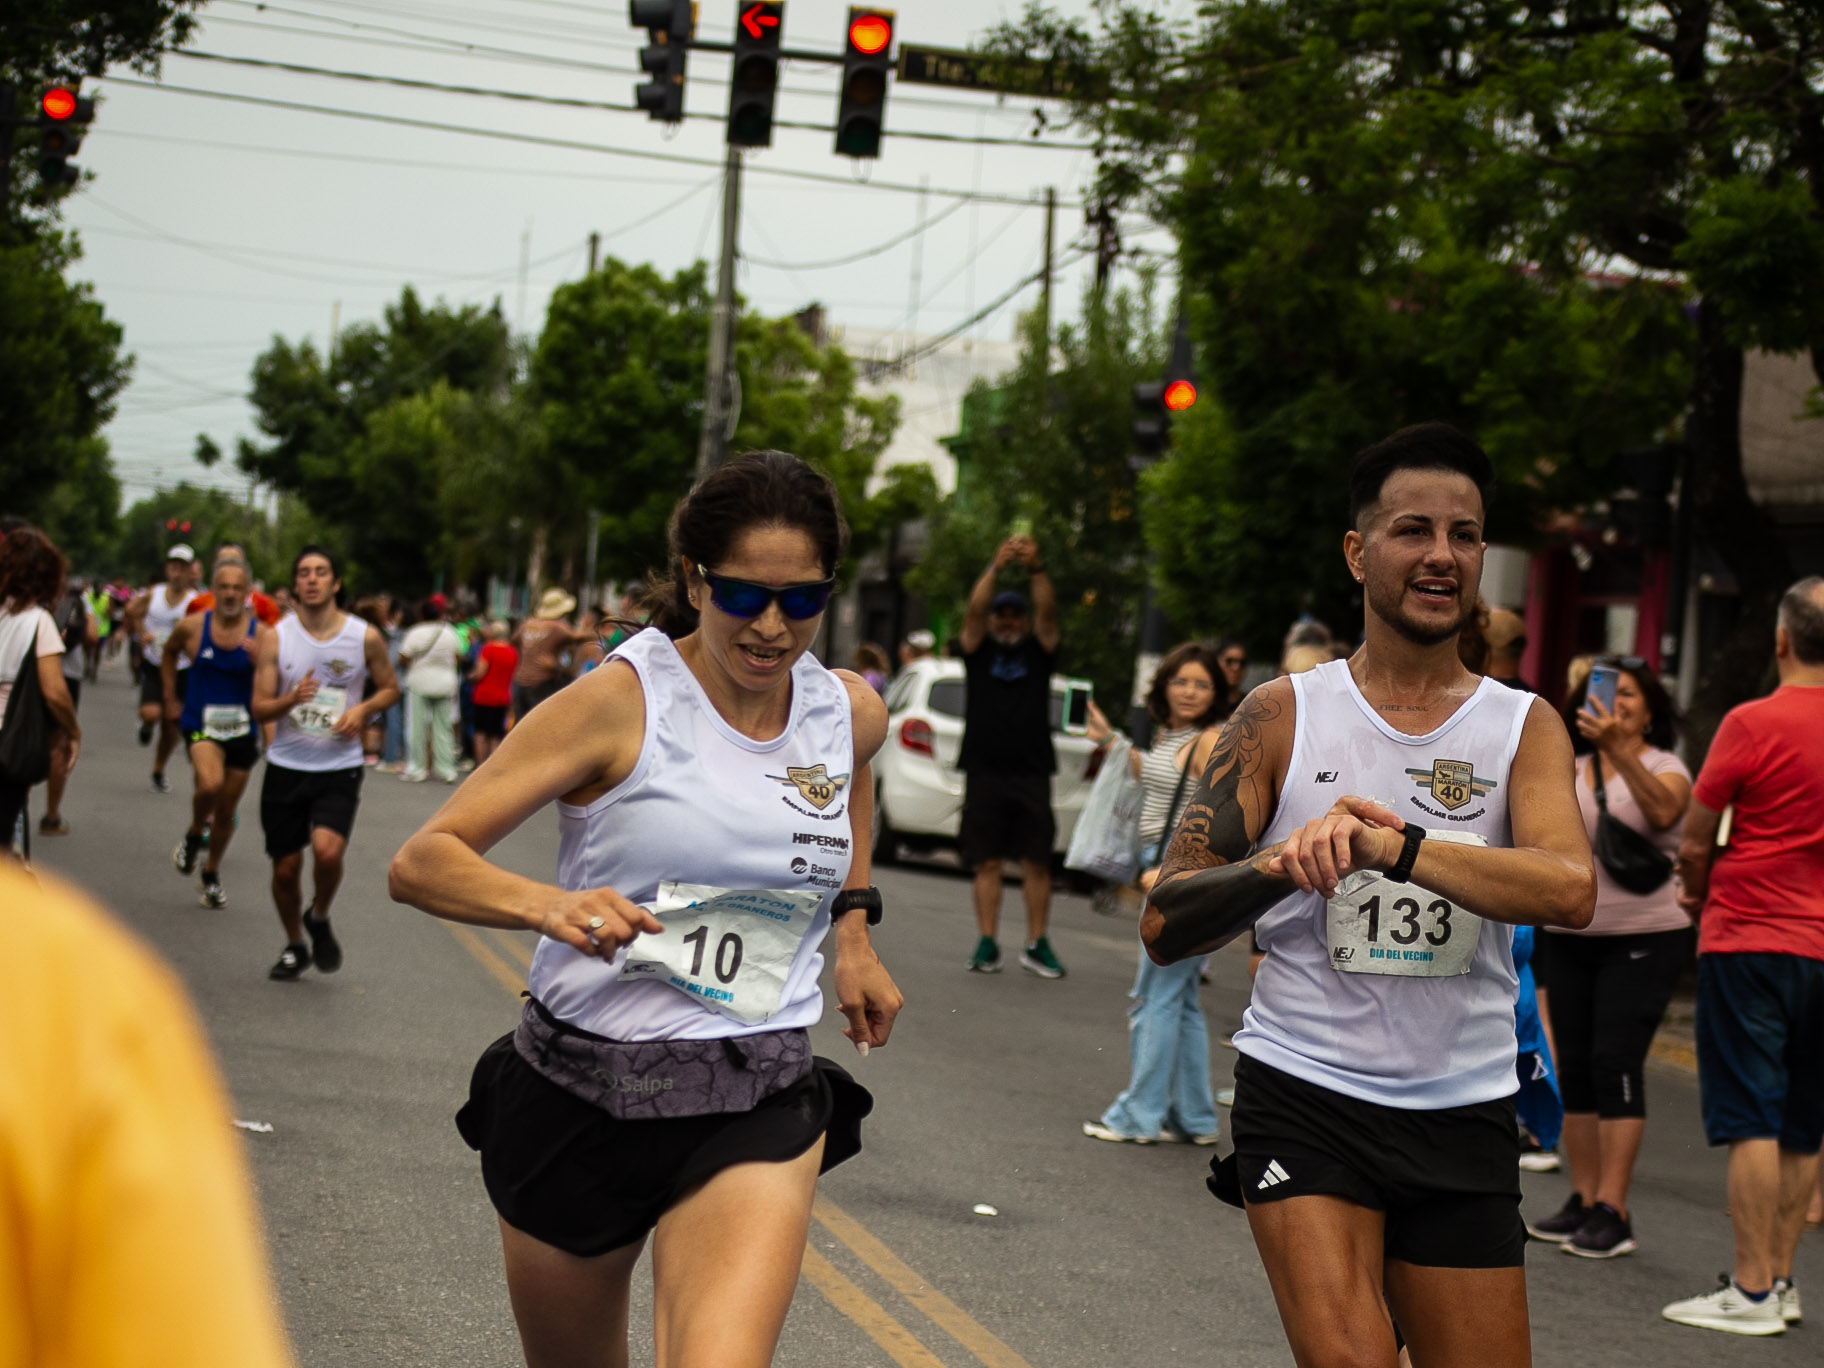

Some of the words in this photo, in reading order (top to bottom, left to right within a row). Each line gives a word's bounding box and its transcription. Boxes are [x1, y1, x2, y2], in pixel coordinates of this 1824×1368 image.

[1315, 771, 1339, 783] NEJ
[808, 785, 831, 800] 40
[1440, 786, 1464, 801] 40
[1410, 796, 1447, 819] EMPALME
[1447, 808, 1486, 822] GRANEROS
[810, 863, 836, 877] Banco
[727, 902, 792, 922] GRANEROS
[1358, 895, 1452, 946] 133
[683, 925, 743, 984] 10
[1333, 947, 1355, 960] NEJ
[1370, 948, 1385, 958] DIA
[1386, 949, 1402, 959] DEL
[1403, 950, 1434, 962] VECINO
[686, 982, 703, 996] DEL
[703, 986, 734, 1003] VECINO
[621, 1074, 674, 1094] Salpa
